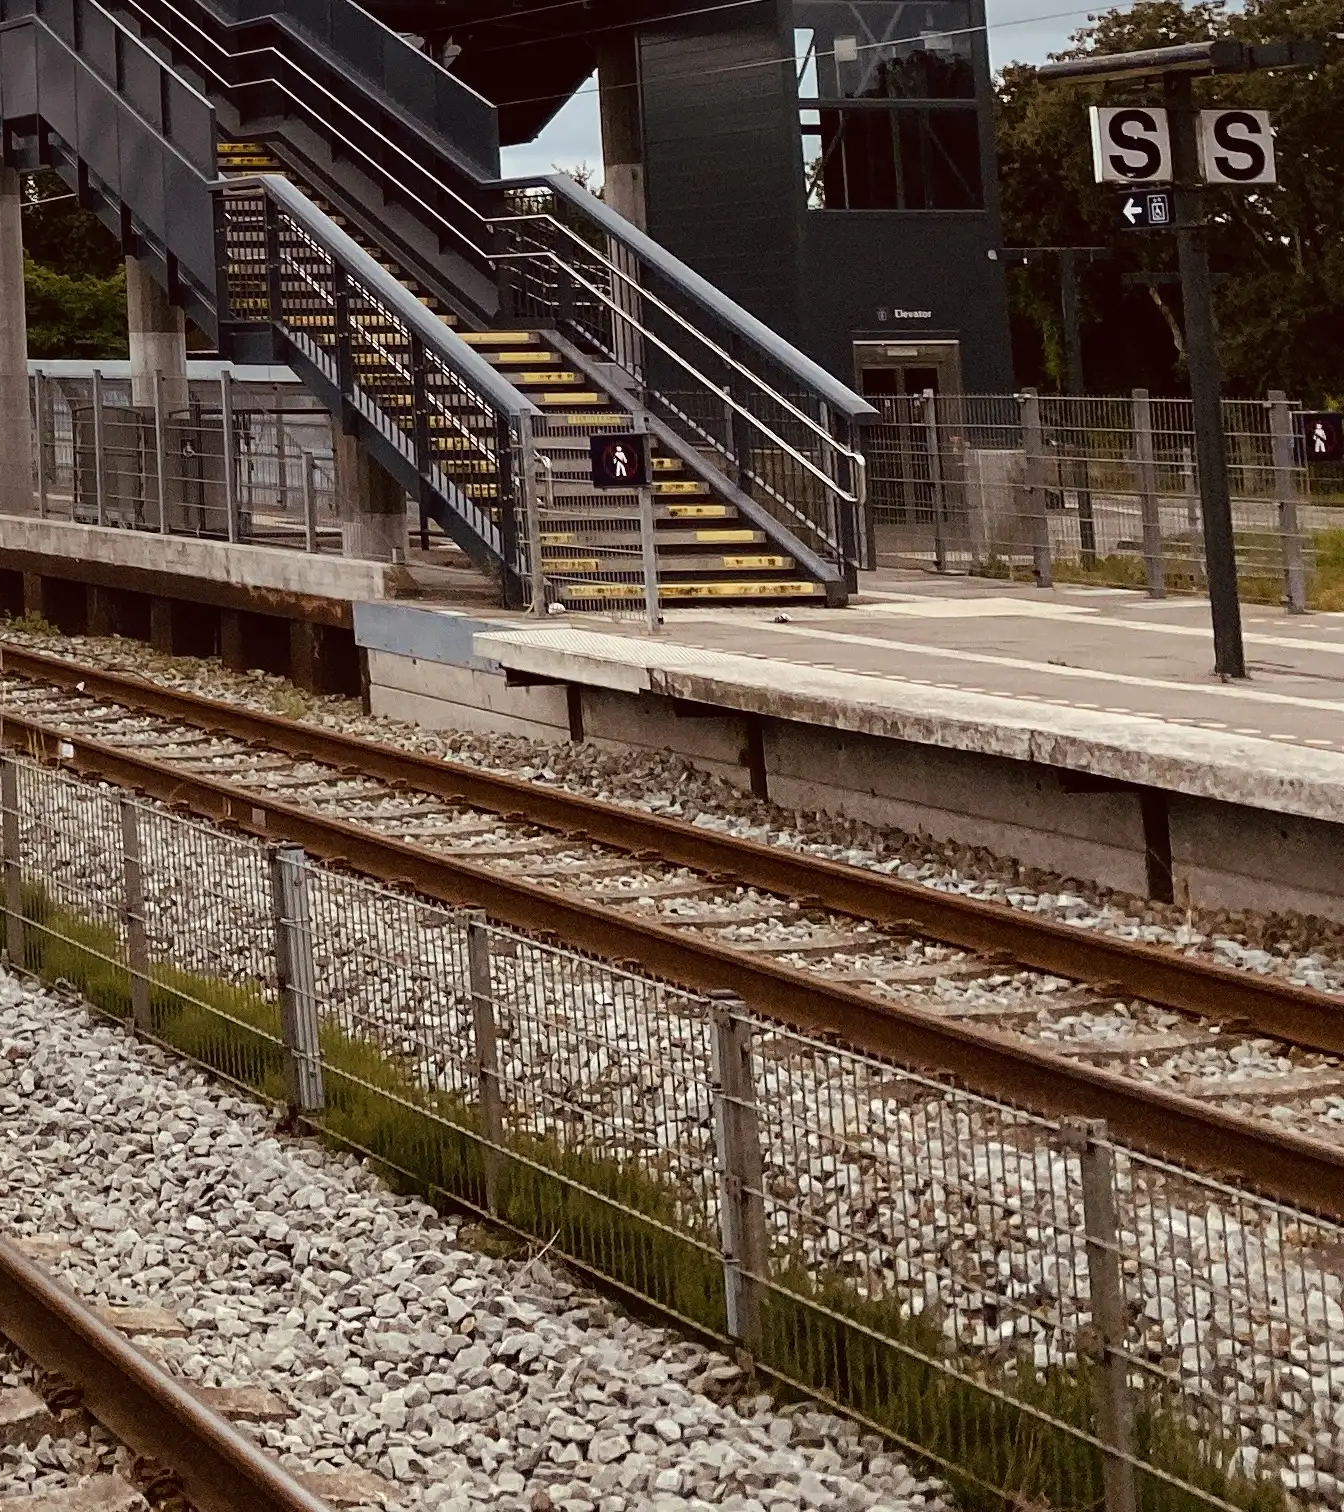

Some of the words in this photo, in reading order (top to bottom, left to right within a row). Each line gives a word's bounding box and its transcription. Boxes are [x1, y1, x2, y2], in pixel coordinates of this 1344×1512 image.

[1108, 109, 1162, 179] S
[1213, 111, 1265, 180] S
[894, 308, 932, 318] Elevator
